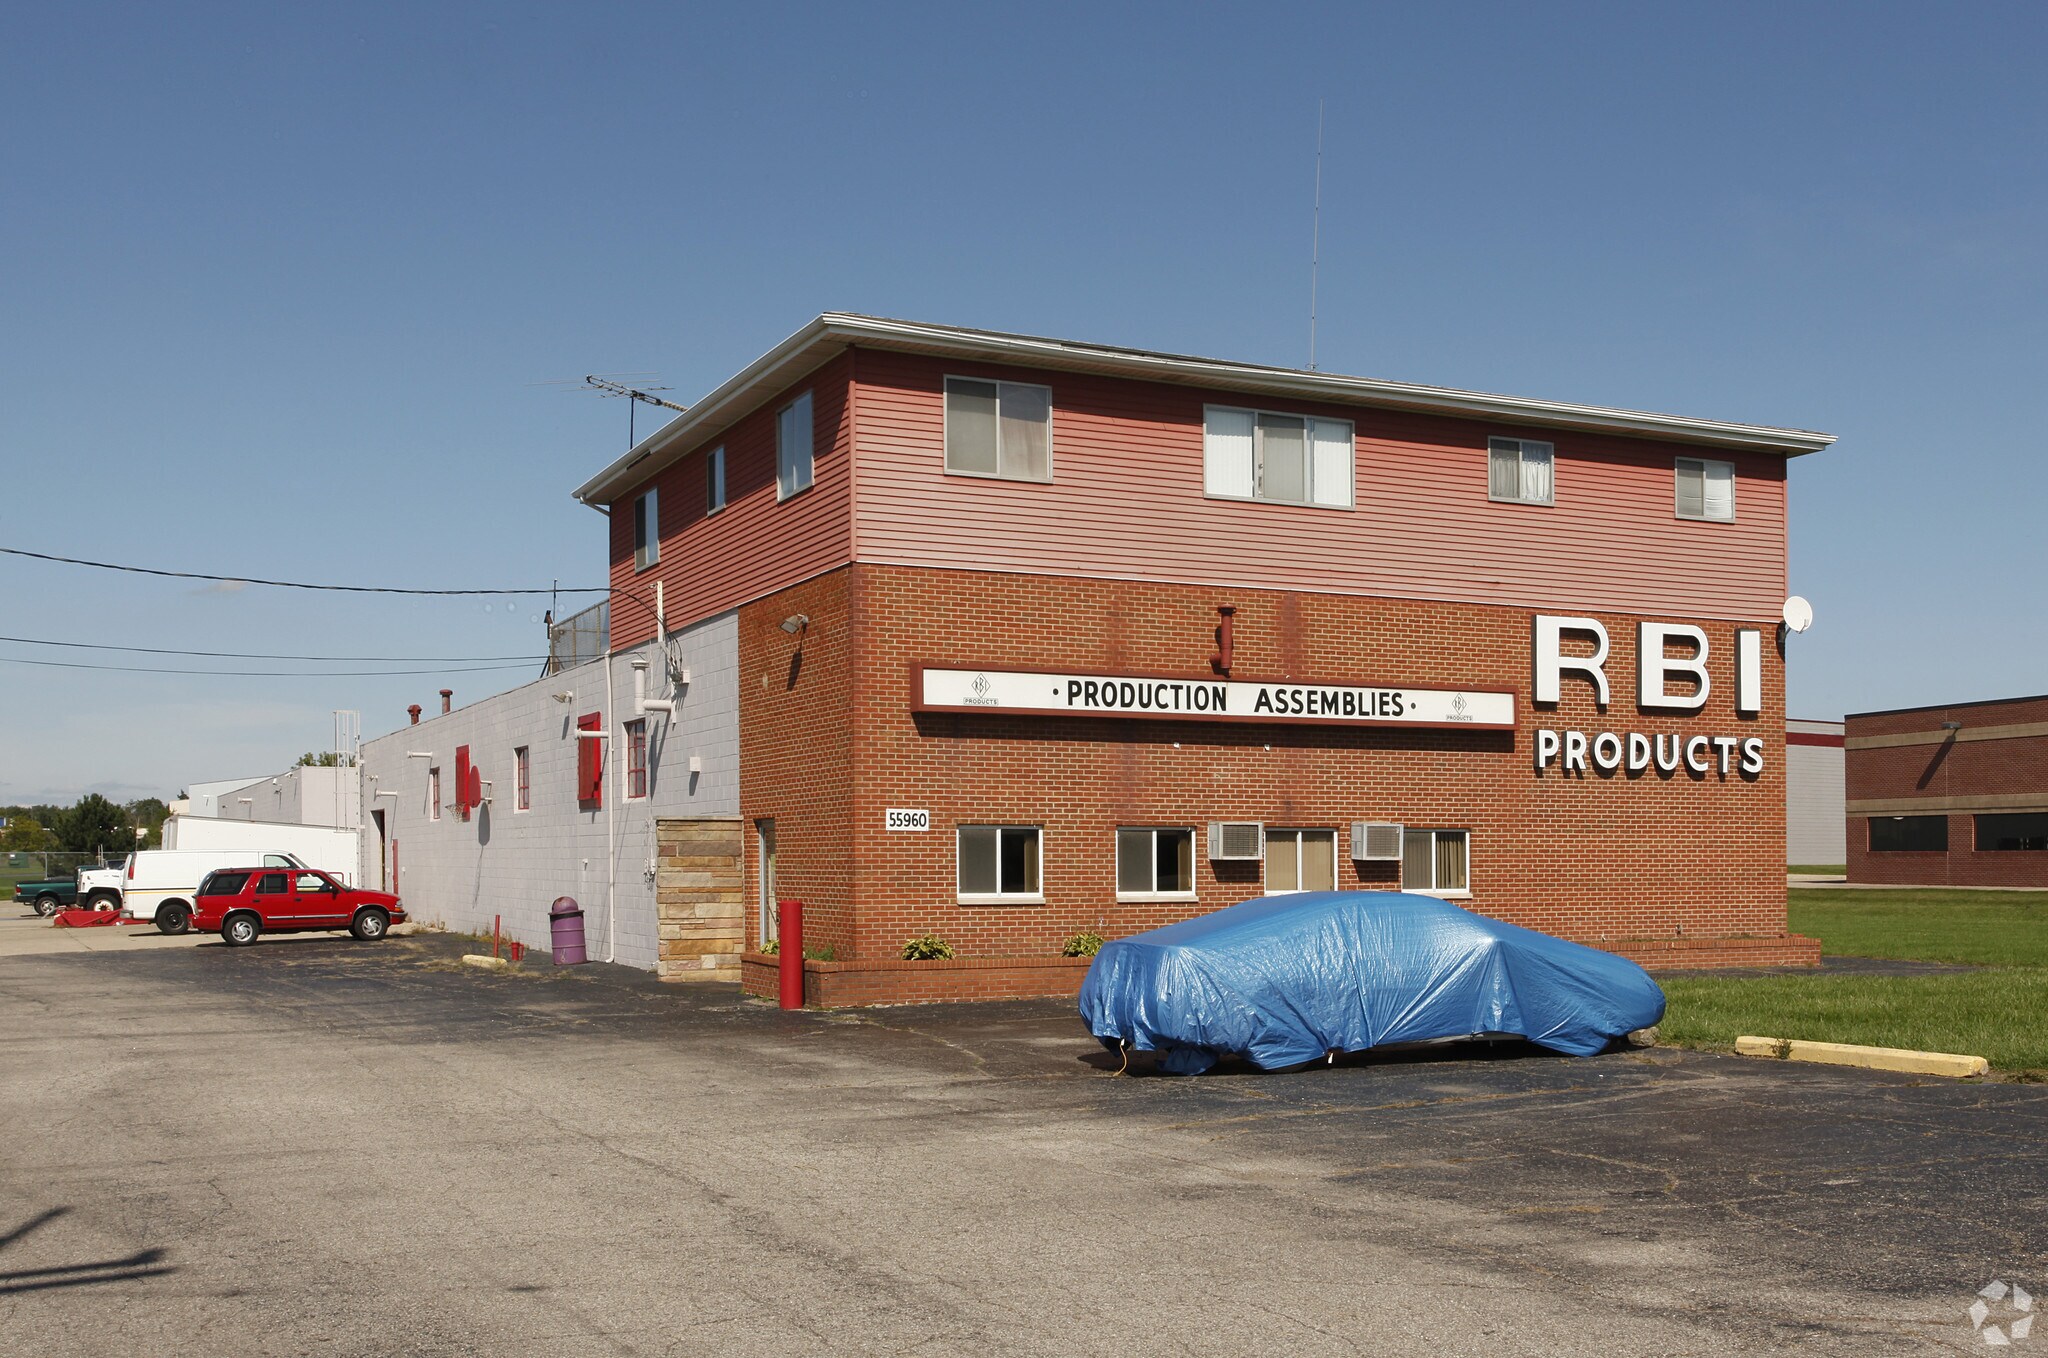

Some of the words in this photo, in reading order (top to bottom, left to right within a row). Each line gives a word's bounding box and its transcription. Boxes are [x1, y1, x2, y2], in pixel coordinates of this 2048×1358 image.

[1534, 614, 1762, 712] RBI
[1067, 680, 1227, 711] PRODUCTION
[1253, 688, 1404, 717] ASSEMBLIES
[1535, 729, 1764, 773] PRODUCTS
[889, 811, 927, 828] 55960
